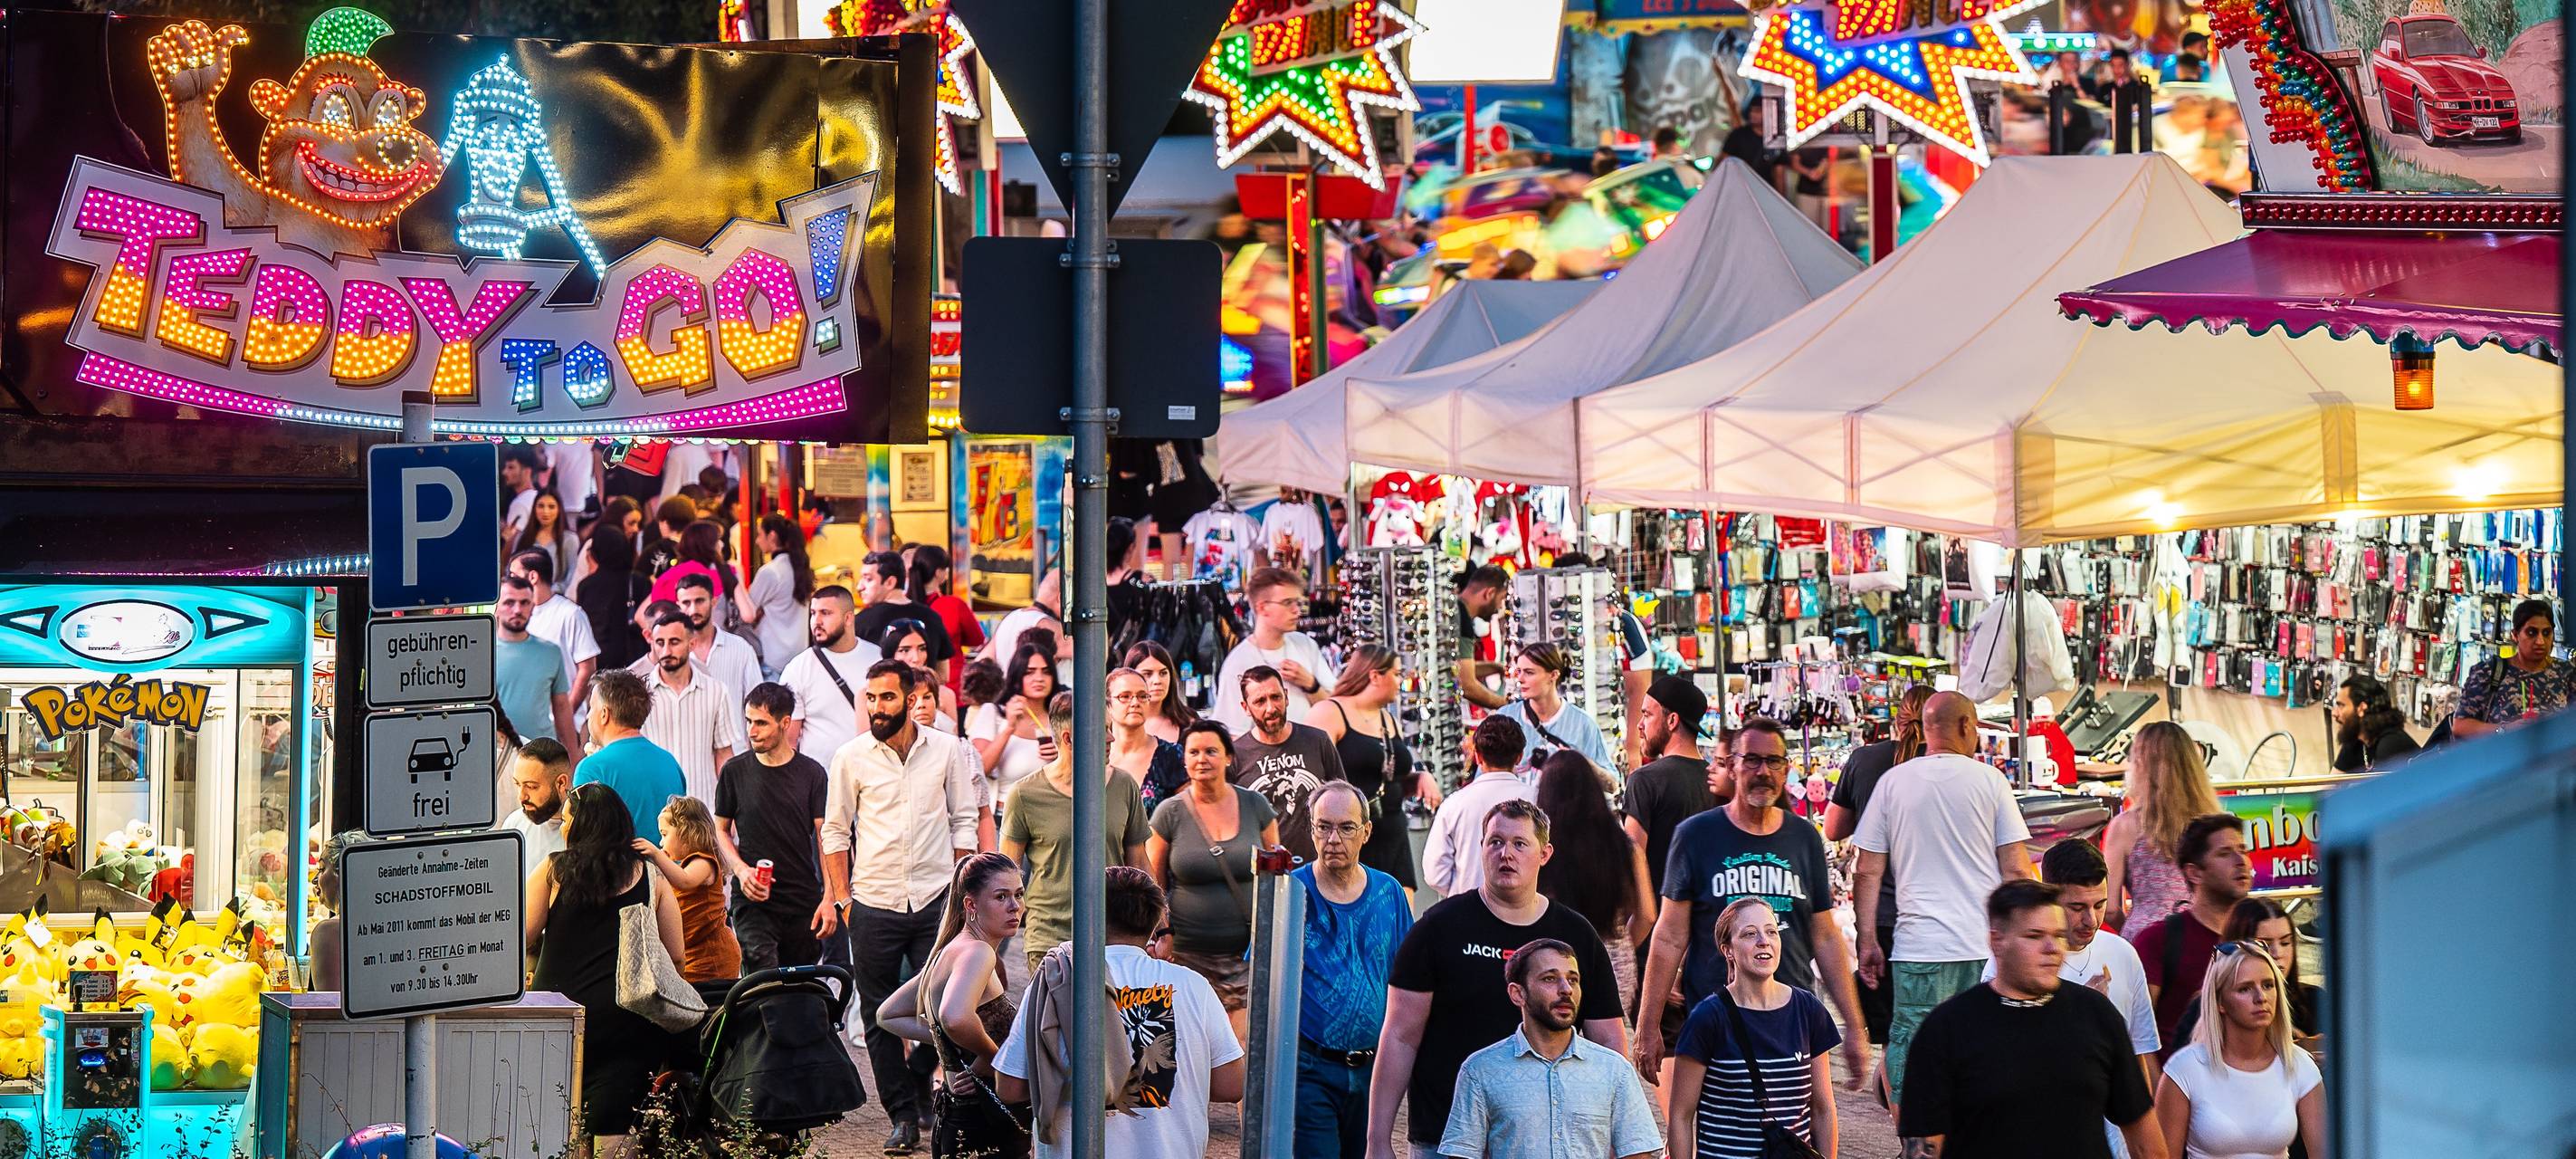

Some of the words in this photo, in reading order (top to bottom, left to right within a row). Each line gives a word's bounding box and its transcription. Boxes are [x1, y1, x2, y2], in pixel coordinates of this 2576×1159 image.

[74, 186, 539, 400] TEDDY
[500, 337, 615, 412] TO
[615, 204, 852, 397] GO!
[402, 466, 467, 587] P
[387, 632, 478, 659] gebühren-
[400, 665, 466, 693] pflichtig
[1256, 753, 1306, 775] VENOM
[413, 792, 451, 818] frei
[377, 865, 419, 878] Geänderte
[422, 858, 489, 875] Annahme-Zeiten
[375, 882, 494, 905] SCHADSTOFFMOBIL
[1712, 865, 1807, 899] ORIGINAL
[357, 924, 367, 936] Ab
[370, 922, 385, 934] Mai
[386, 919, 404, 933] 2011
[406, 915, 436, 931] kommt
[439, 914, 453, 927] das
[455, 911, 476, 925] Mobil
[479, 911, 491, 924] der
[494, 909, 510, 922] MEG
[363, 955, 376, 966] am
[379, 953, 386, 964] 1.
[389, 951, 404, 963] und
[406, 949, 415, 962] 3.
[418, 943, 465, 962] FREITAG
[467, 943, 477, 954] im
[480, 939, 504, 953] Monat
[390, 979, 405, 993] von
[408, 975, 426, 991] 9.30
[429, 973, 440, 989] bis
[444, 972, 479, 988] 14.30Uhr
